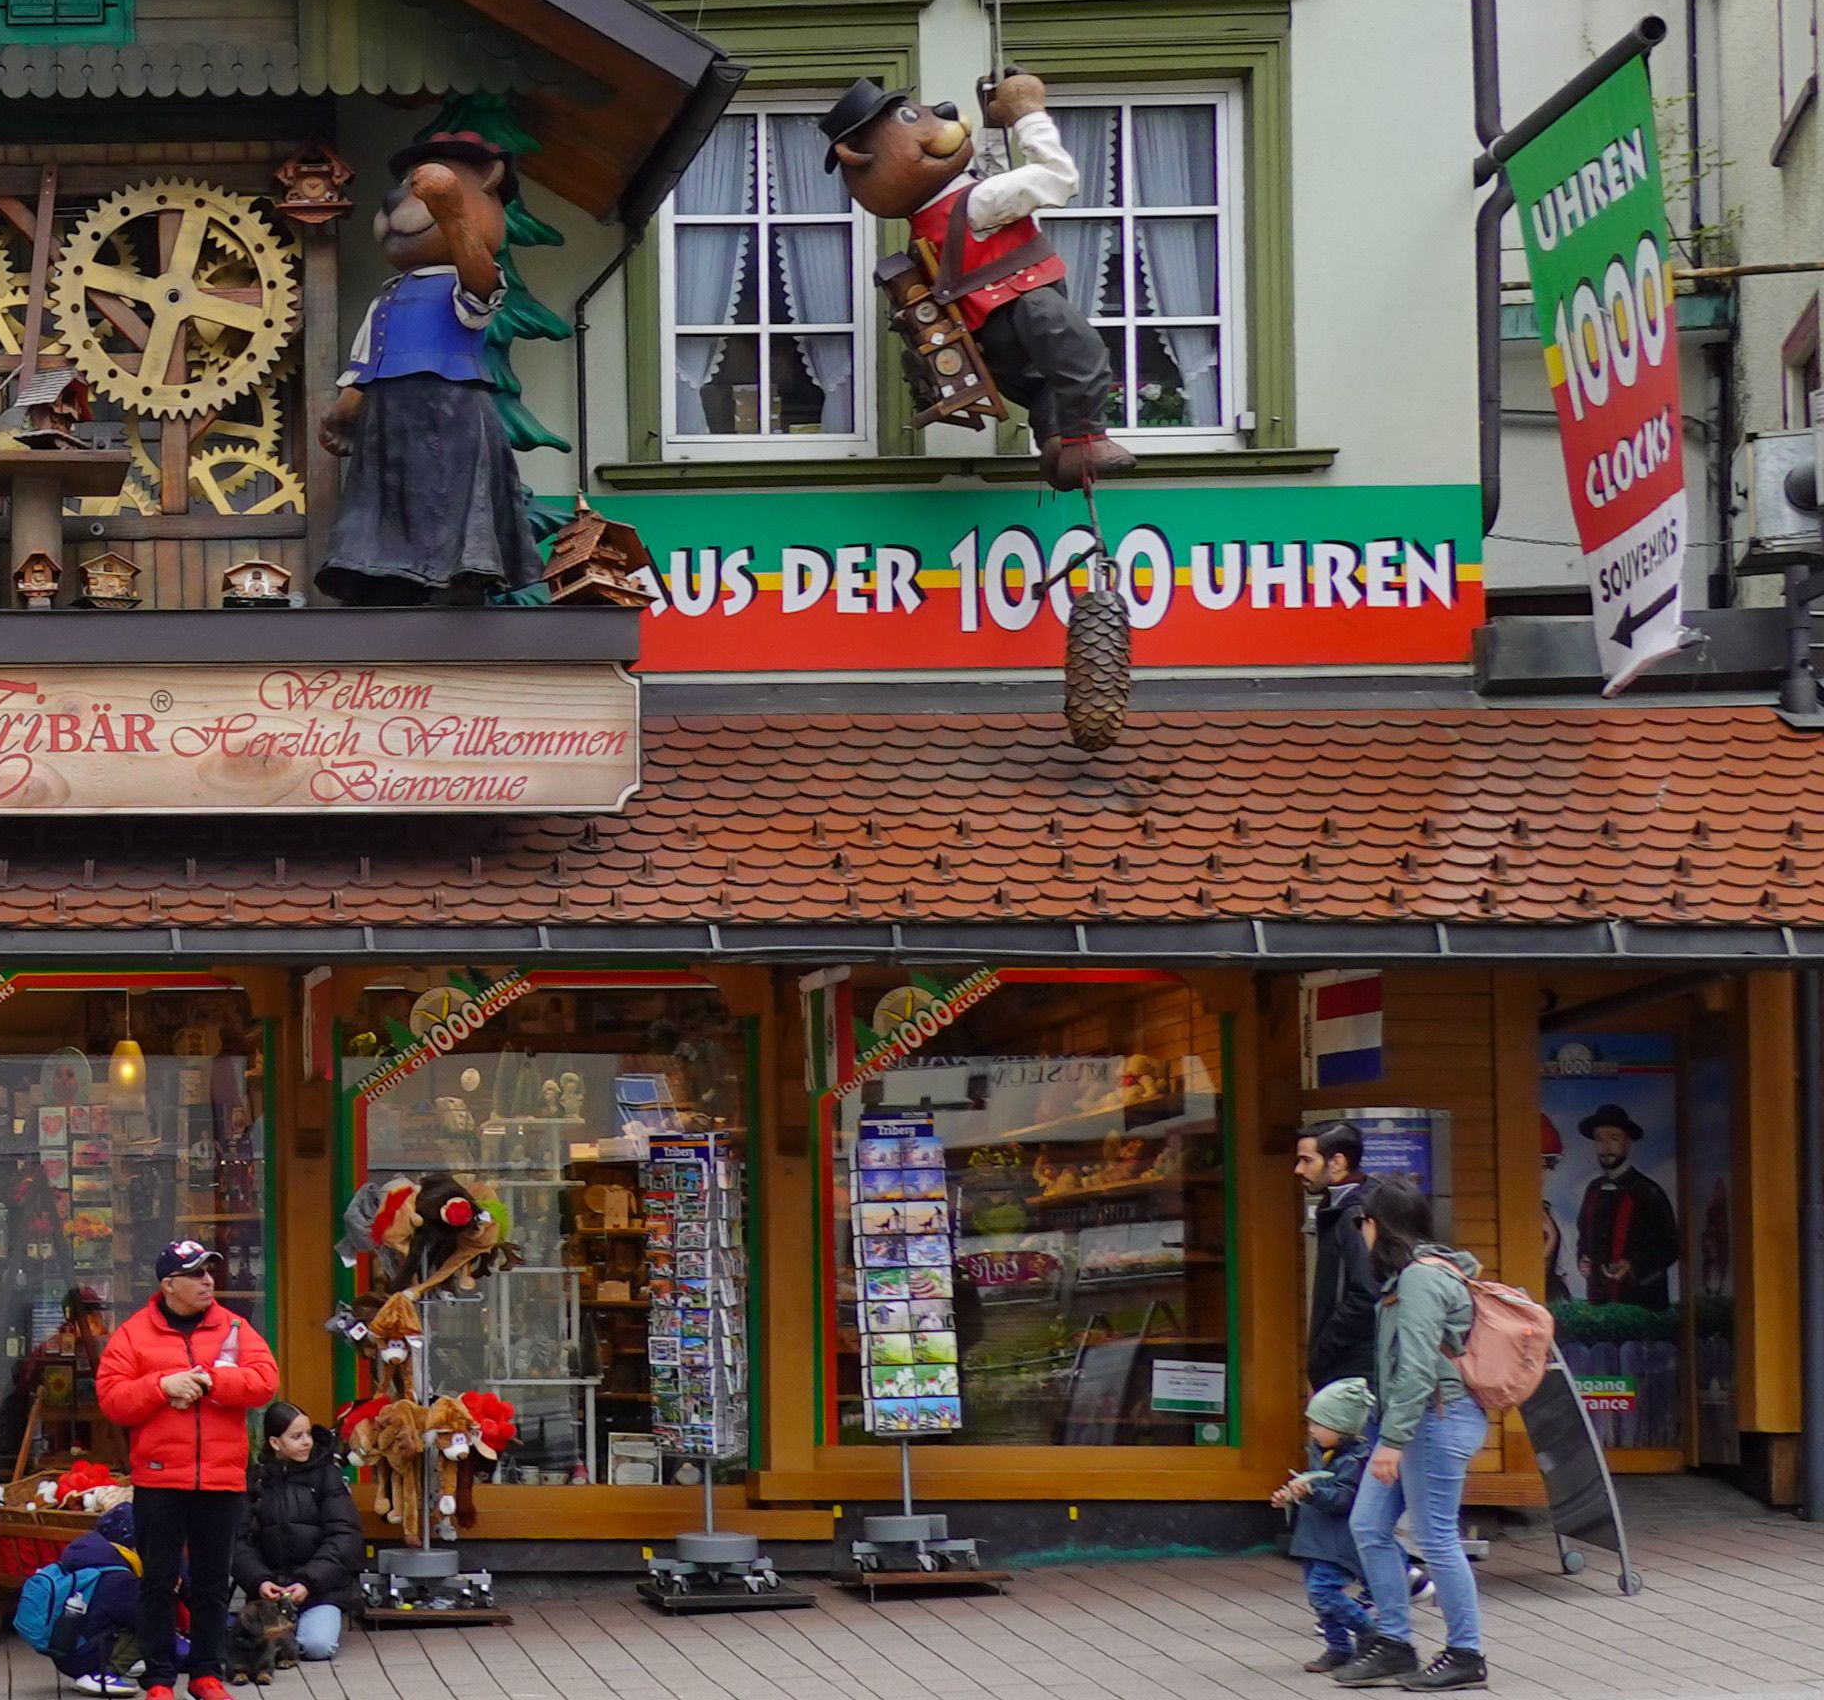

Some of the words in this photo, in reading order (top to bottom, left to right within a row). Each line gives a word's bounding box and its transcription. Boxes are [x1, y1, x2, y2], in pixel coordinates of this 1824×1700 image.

[1531, 126, 1649, 252] UHREN
[1556, 230, 1667, 422] 1000
[1585, 408, 1675, 508] CLOCKS
[630, 544, 757, 619] AUS
[782, 543, 926, 615] DER
[953, 523, 1176, 633] 1000
[1192, 537, 1458, 612] UHREN
[1599, 516, 1678, 603] SOUVENIRS
[170, 713, 359, 757] Herzlich
[378, 716, 630, 757] Willkommen
[258, 669, 433, 711] Welkom
[309, 760, 529, 802] Bienvenue
[357, 1061, 394, 1092] HAUS
[395, 1042, 422, 1064] DER
[423, 1001, 485, 1058] 1000
[475, 970, 521, 1006] UHREN
[365, 1068, 408, 1103] HOUSE
[411, 1053, 430, 1069] OF
[485, 980, 532, 1016] CLOCKS
[833, 1065, 878, 1101] HOUSE
[880, 1049, 899, 1067] OF
[955, 976, 1001, 1014] CLOCKS
[863, 1038, 890, 1061] DER
[891, 998, 953, 1055] 1000
[945, 967, 991, 1002] UHREN
[663, 1147, 695, 1158] Triberg
[877, 1126, 915, 1136] Triberg
[1574, 1379, 1627, 1393] ngang
